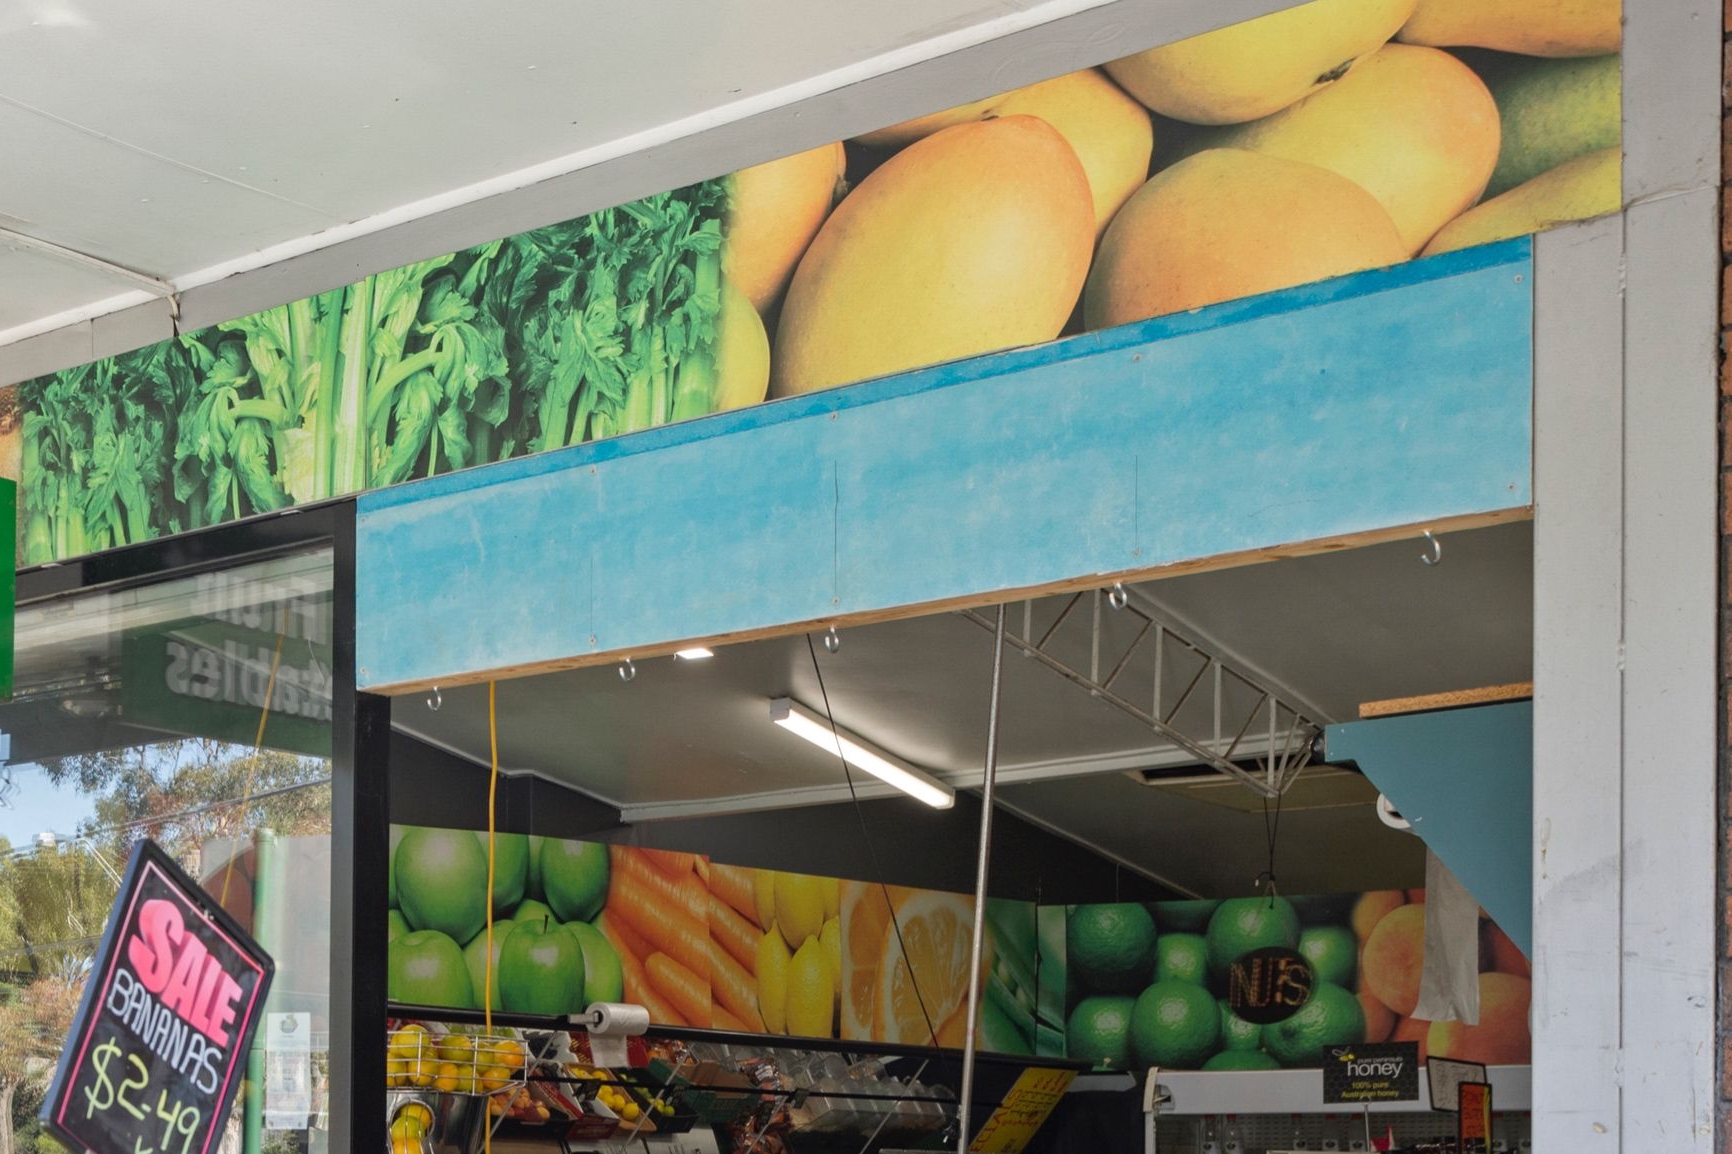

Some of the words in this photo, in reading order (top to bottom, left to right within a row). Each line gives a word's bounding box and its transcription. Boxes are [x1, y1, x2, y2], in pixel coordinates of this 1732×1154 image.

[128, 899, 244, 1049] SALE
[107, 968, 223, 1095] BANANAS
[1347, 1061, 1403, 1079] honey
[1377, 1089, 1399, 1098] honey
